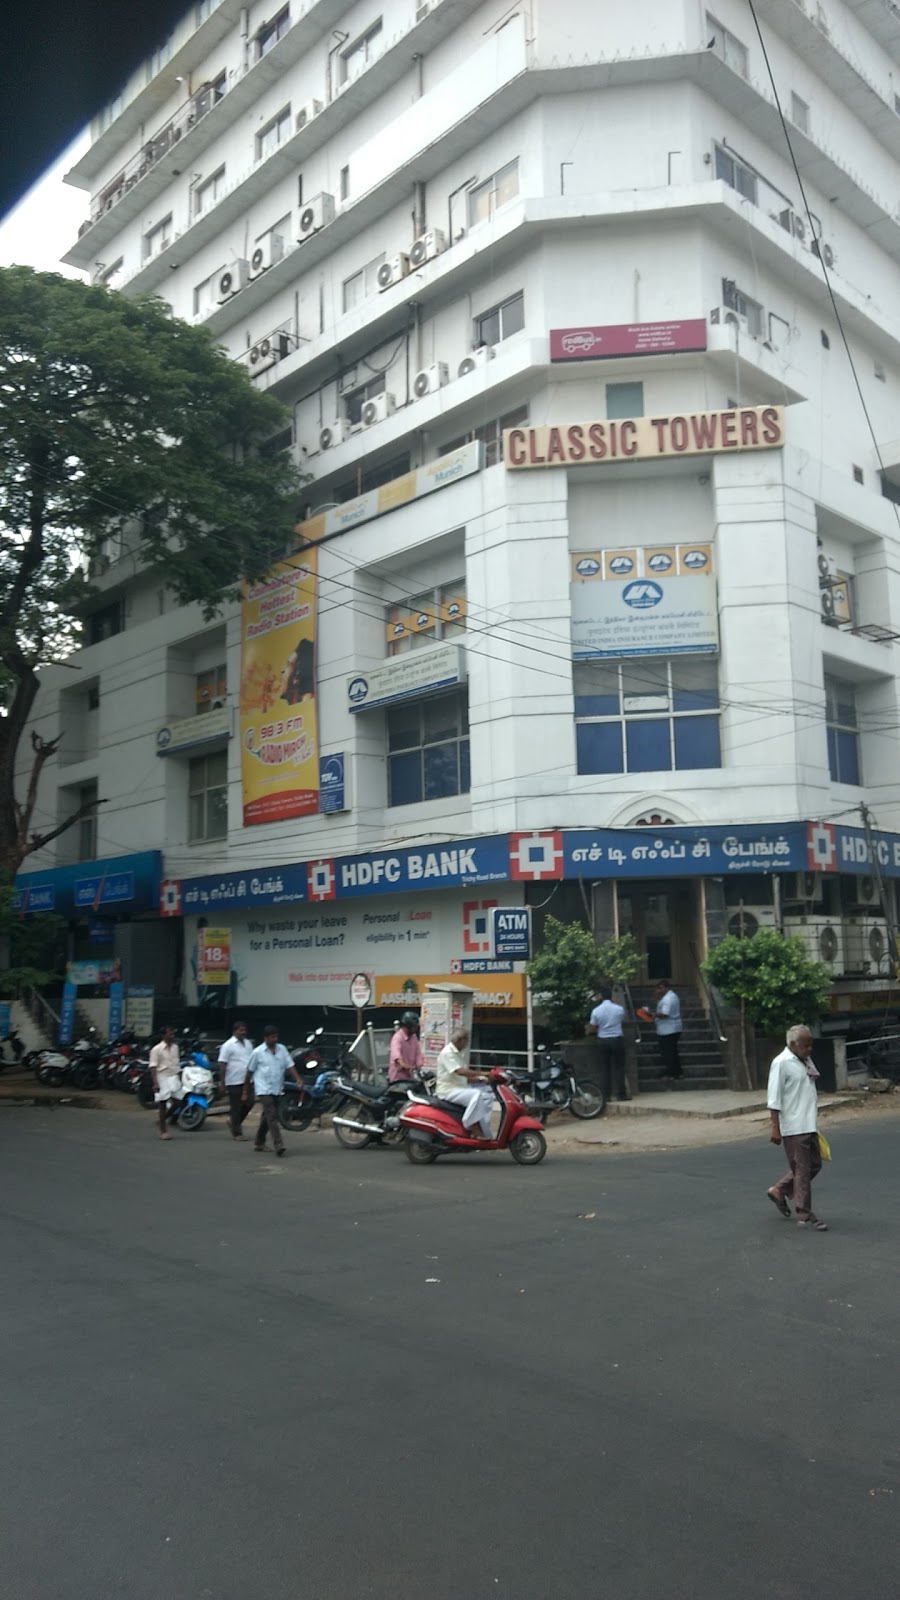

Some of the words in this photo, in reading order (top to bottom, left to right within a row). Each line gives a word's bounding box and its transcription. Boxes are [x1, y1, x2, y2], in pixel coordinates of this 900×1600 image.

[507, 420, 638, 466] CLASSIC
[651, 407, 782, 453] TOWERS
[434, 463, 464, 483] Munich
[246, 619, 273, 637] Radio
[274, 605, 310, 626] Station
[260, 722, 283, 739] 98.3
[286, 717, 303, 731] FM
[608, 846, 627, 865] டி
[691, 837, 711, 857] சி
[721, 835, 790, 857] பேங்க்
[341, 857, 400, 887] HDFC
[407, 847, 478, 880] BANK
[247, 919, 266, 934] Why
[268, 918, 295, 931] waste
[297, 918, 319, 933] your
[321, 915, 348, 928] leave
[362, 911, 401, 925] Personal
[497, 914, 528, 930] ATM
[250, 939, 263, 951] for
[264, 940, 271, 950] a
[272, 934, 313, 950] Personal
[315, 933, 345, 948] Loan?
[406, 929, 412, 942] 1
[463, 961, 486, 971] HDFC
[486, 960, 511, 971] BANK
